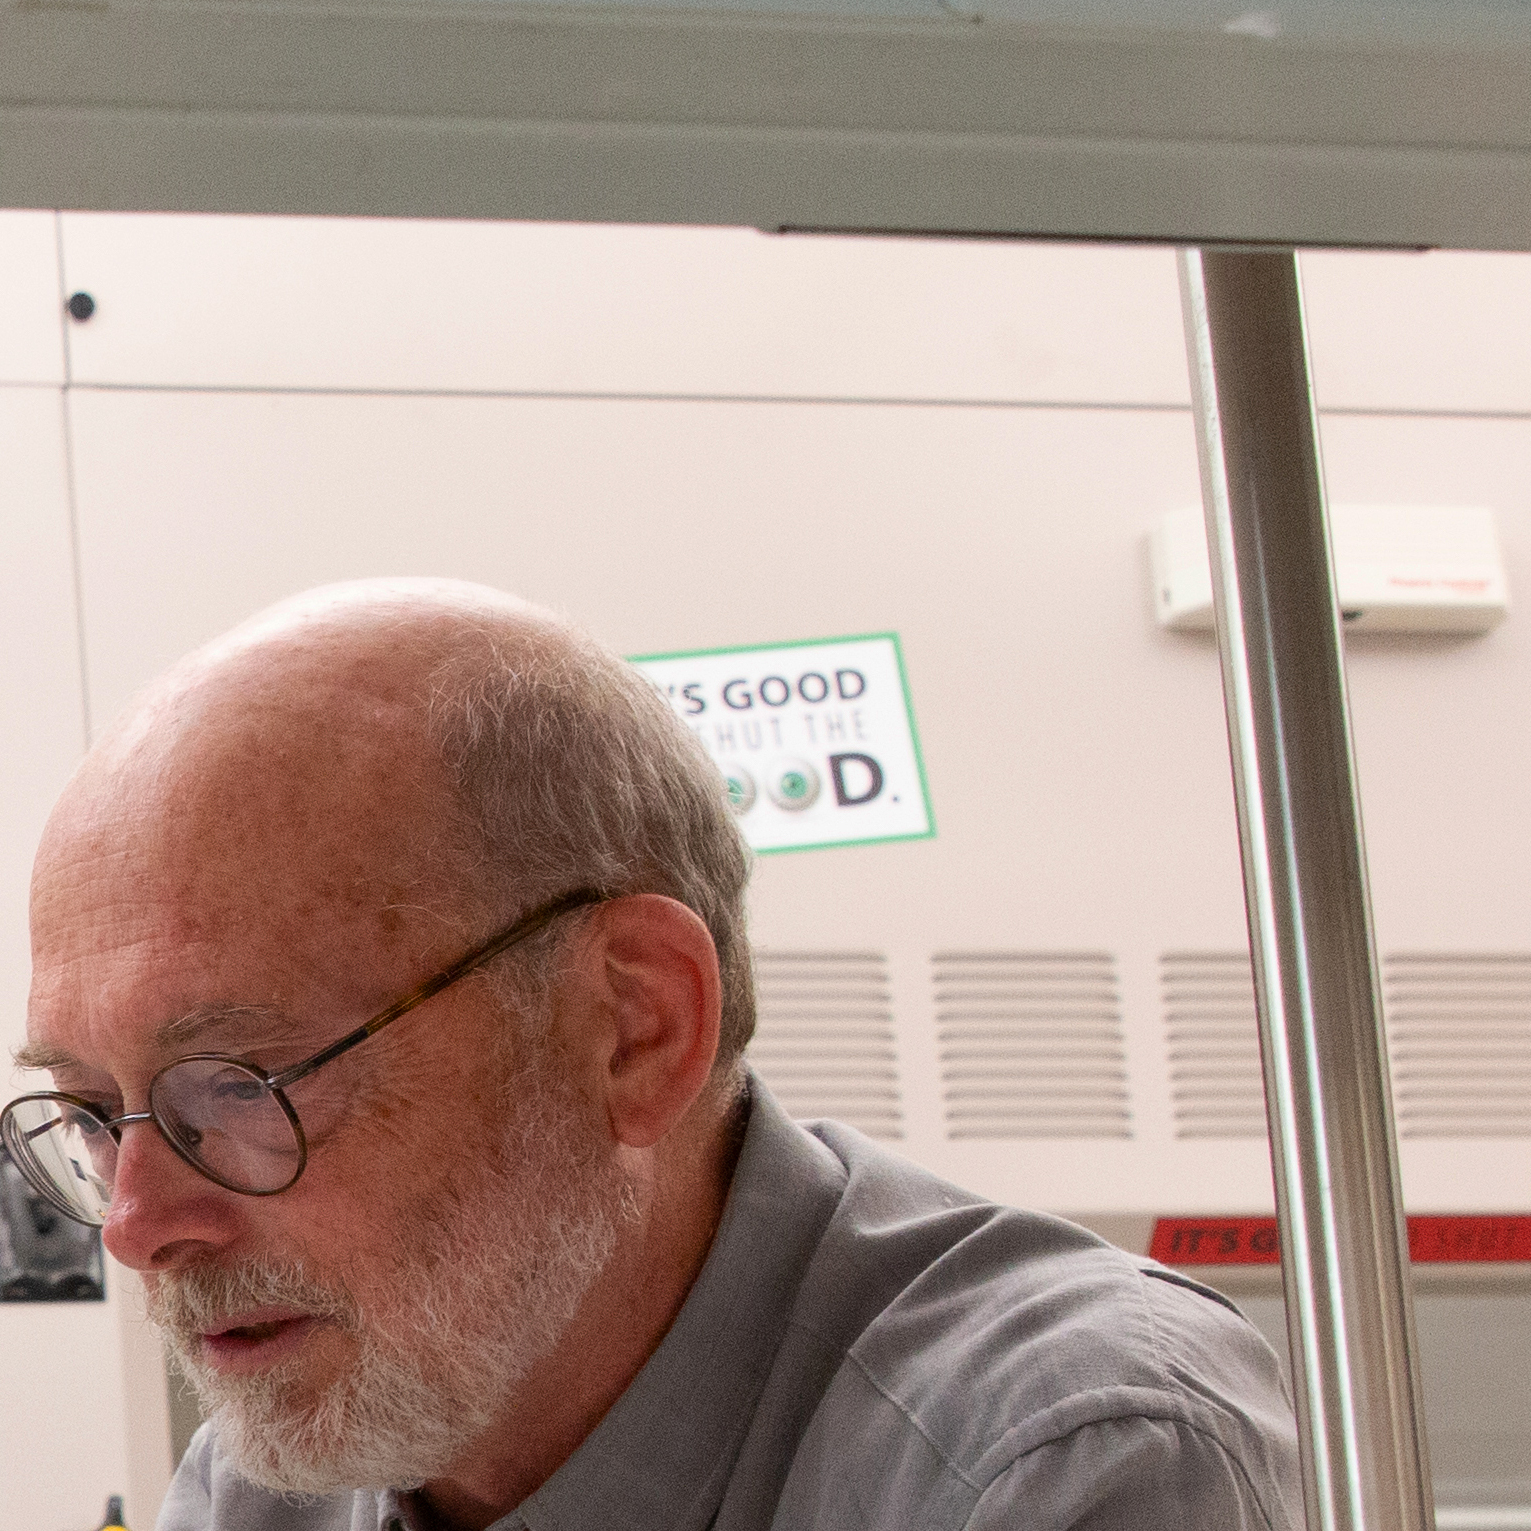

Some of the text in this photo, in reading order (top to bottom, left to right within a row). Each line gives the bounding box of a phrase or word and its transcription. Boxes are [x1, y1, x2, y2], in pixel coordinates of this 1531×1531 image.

[667, 667, 866, 715] 'S GOOD
[713, 708, 872, 752] HUT THE
